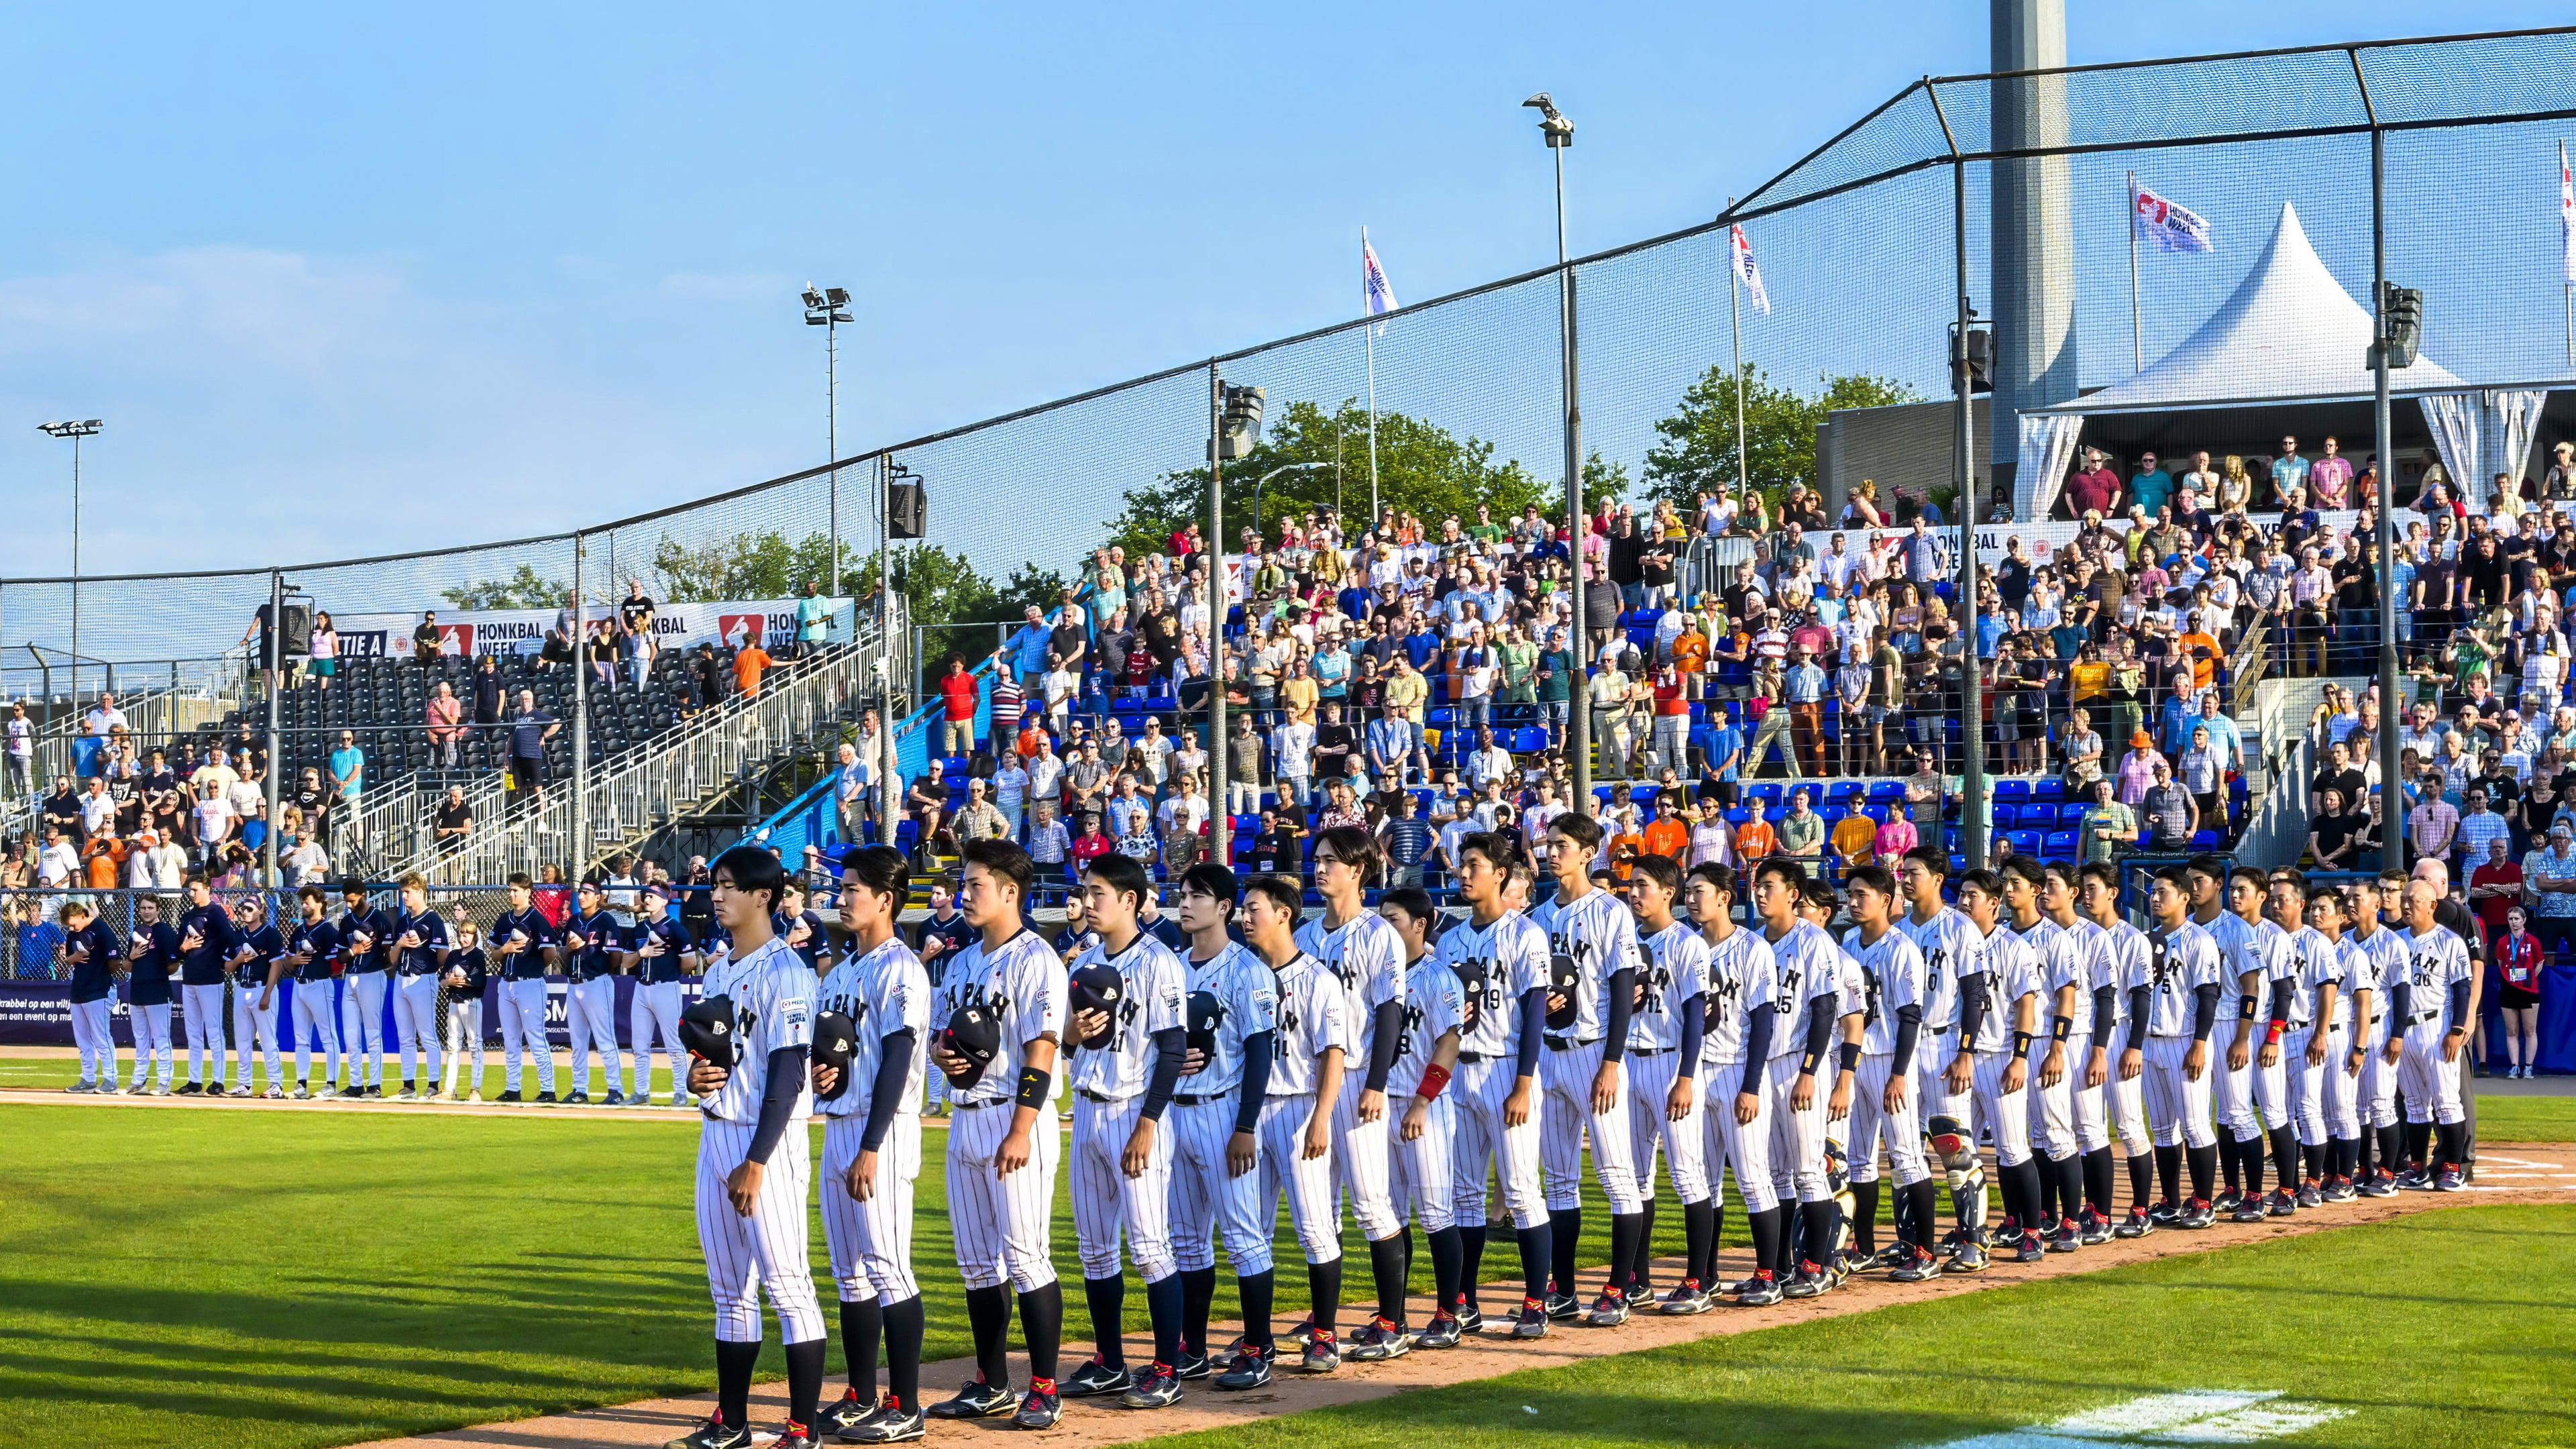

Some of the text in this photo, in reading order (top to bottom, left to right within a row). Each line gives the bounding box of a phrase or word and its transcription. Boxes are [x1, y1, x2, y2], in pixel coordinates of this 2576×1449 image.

[477, 622, 543, 640] HONKBAL
[651, 616, 687, 634] KBAL
[478, 641, 517, 655] WEEK
[28, 1001, 38, 1010] op
[1482, 988, 1500, 1010] 19
[1648, 993, 1662, 1014] 12
[48, 1014, 58, 1023] op
